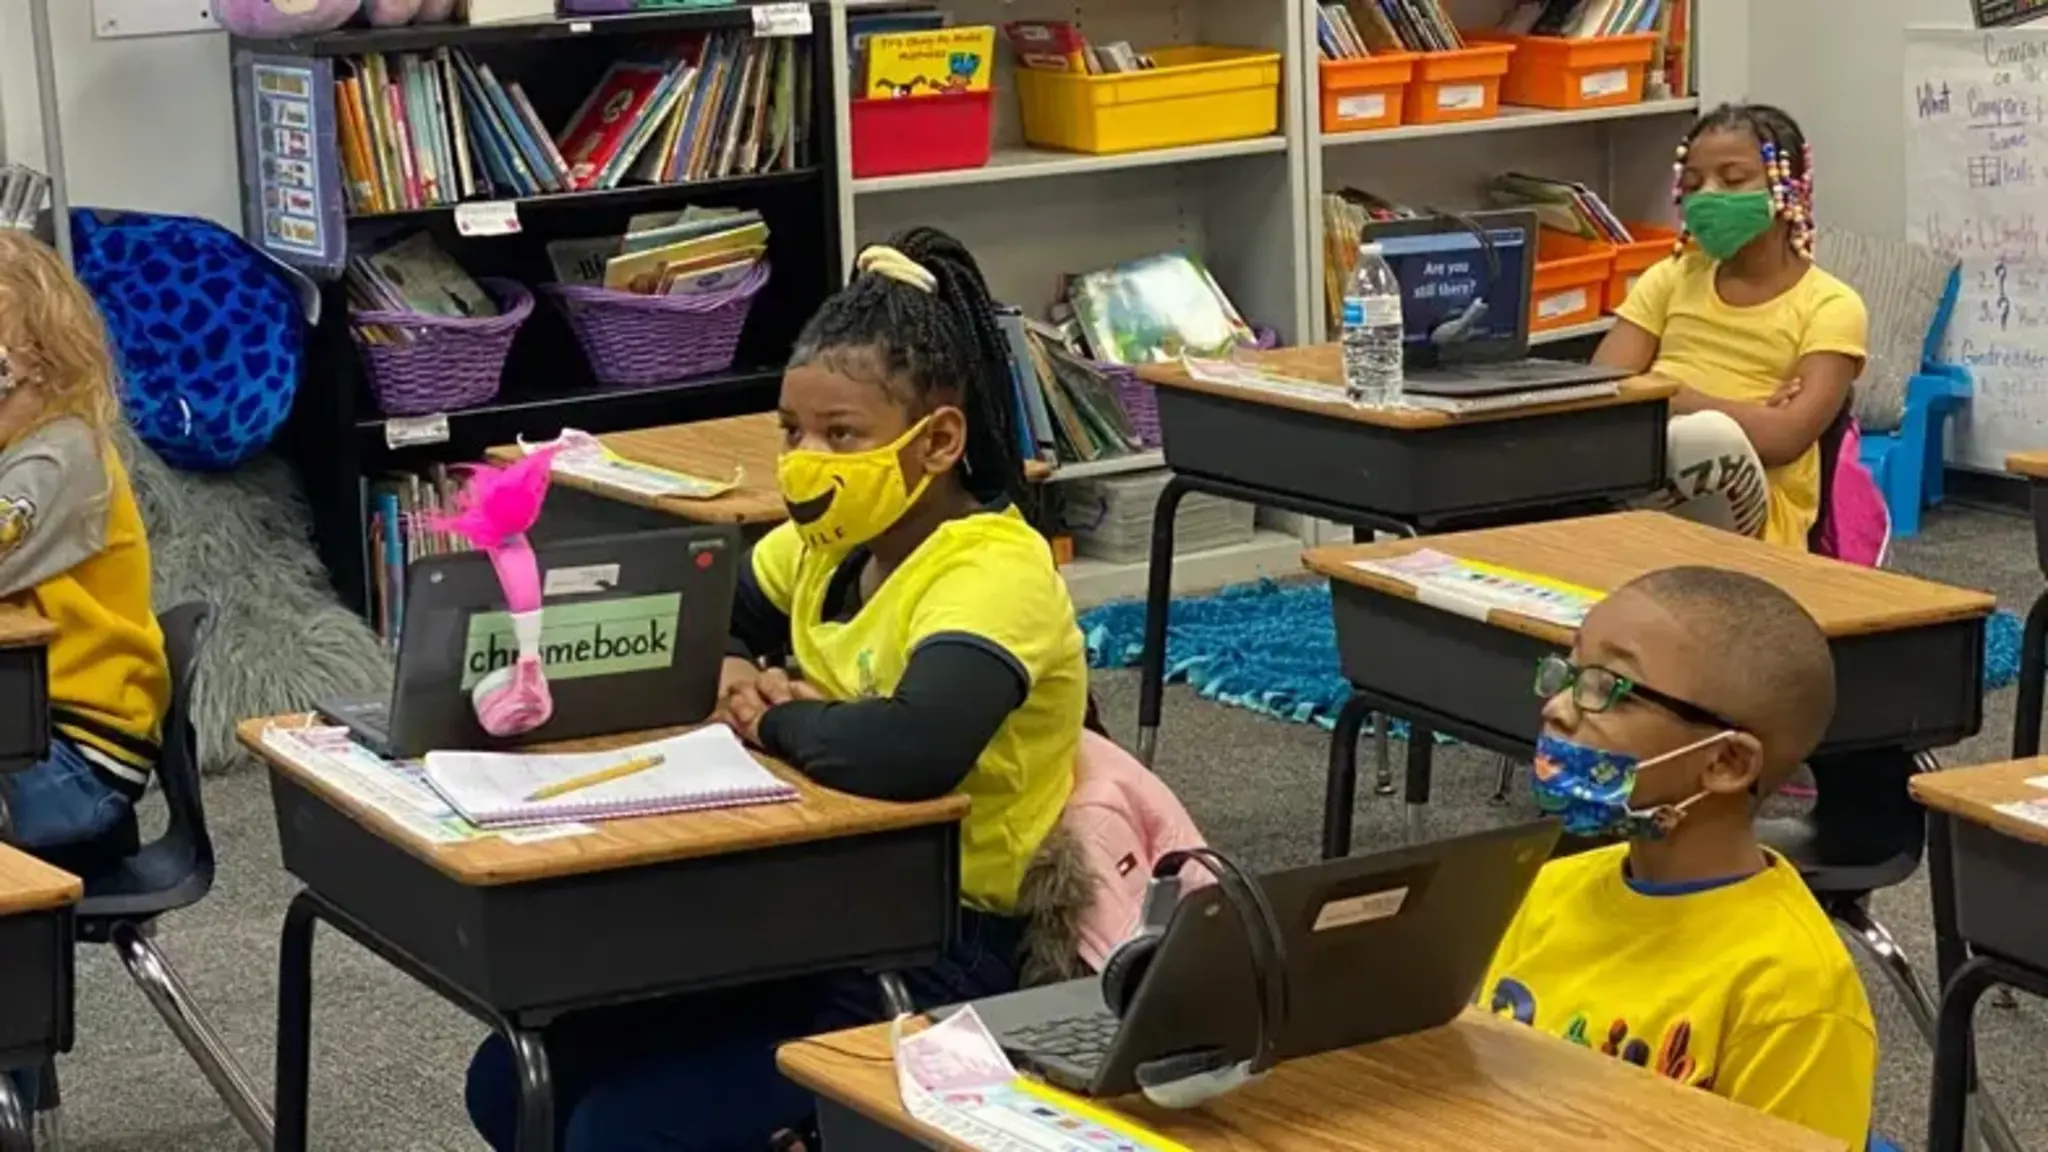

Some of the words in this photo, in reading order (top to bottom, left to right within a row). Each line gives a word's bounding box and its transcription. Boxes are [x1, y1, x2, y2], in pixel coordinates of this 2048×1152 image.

[1423, 261, 1445, 276] Are
[1447, 261, 1469, 277] you
[1413, 282, 1435, 299] still
[1438, 279, 1477, 296] there?
[469, 619, 668, 674] chrmebook
